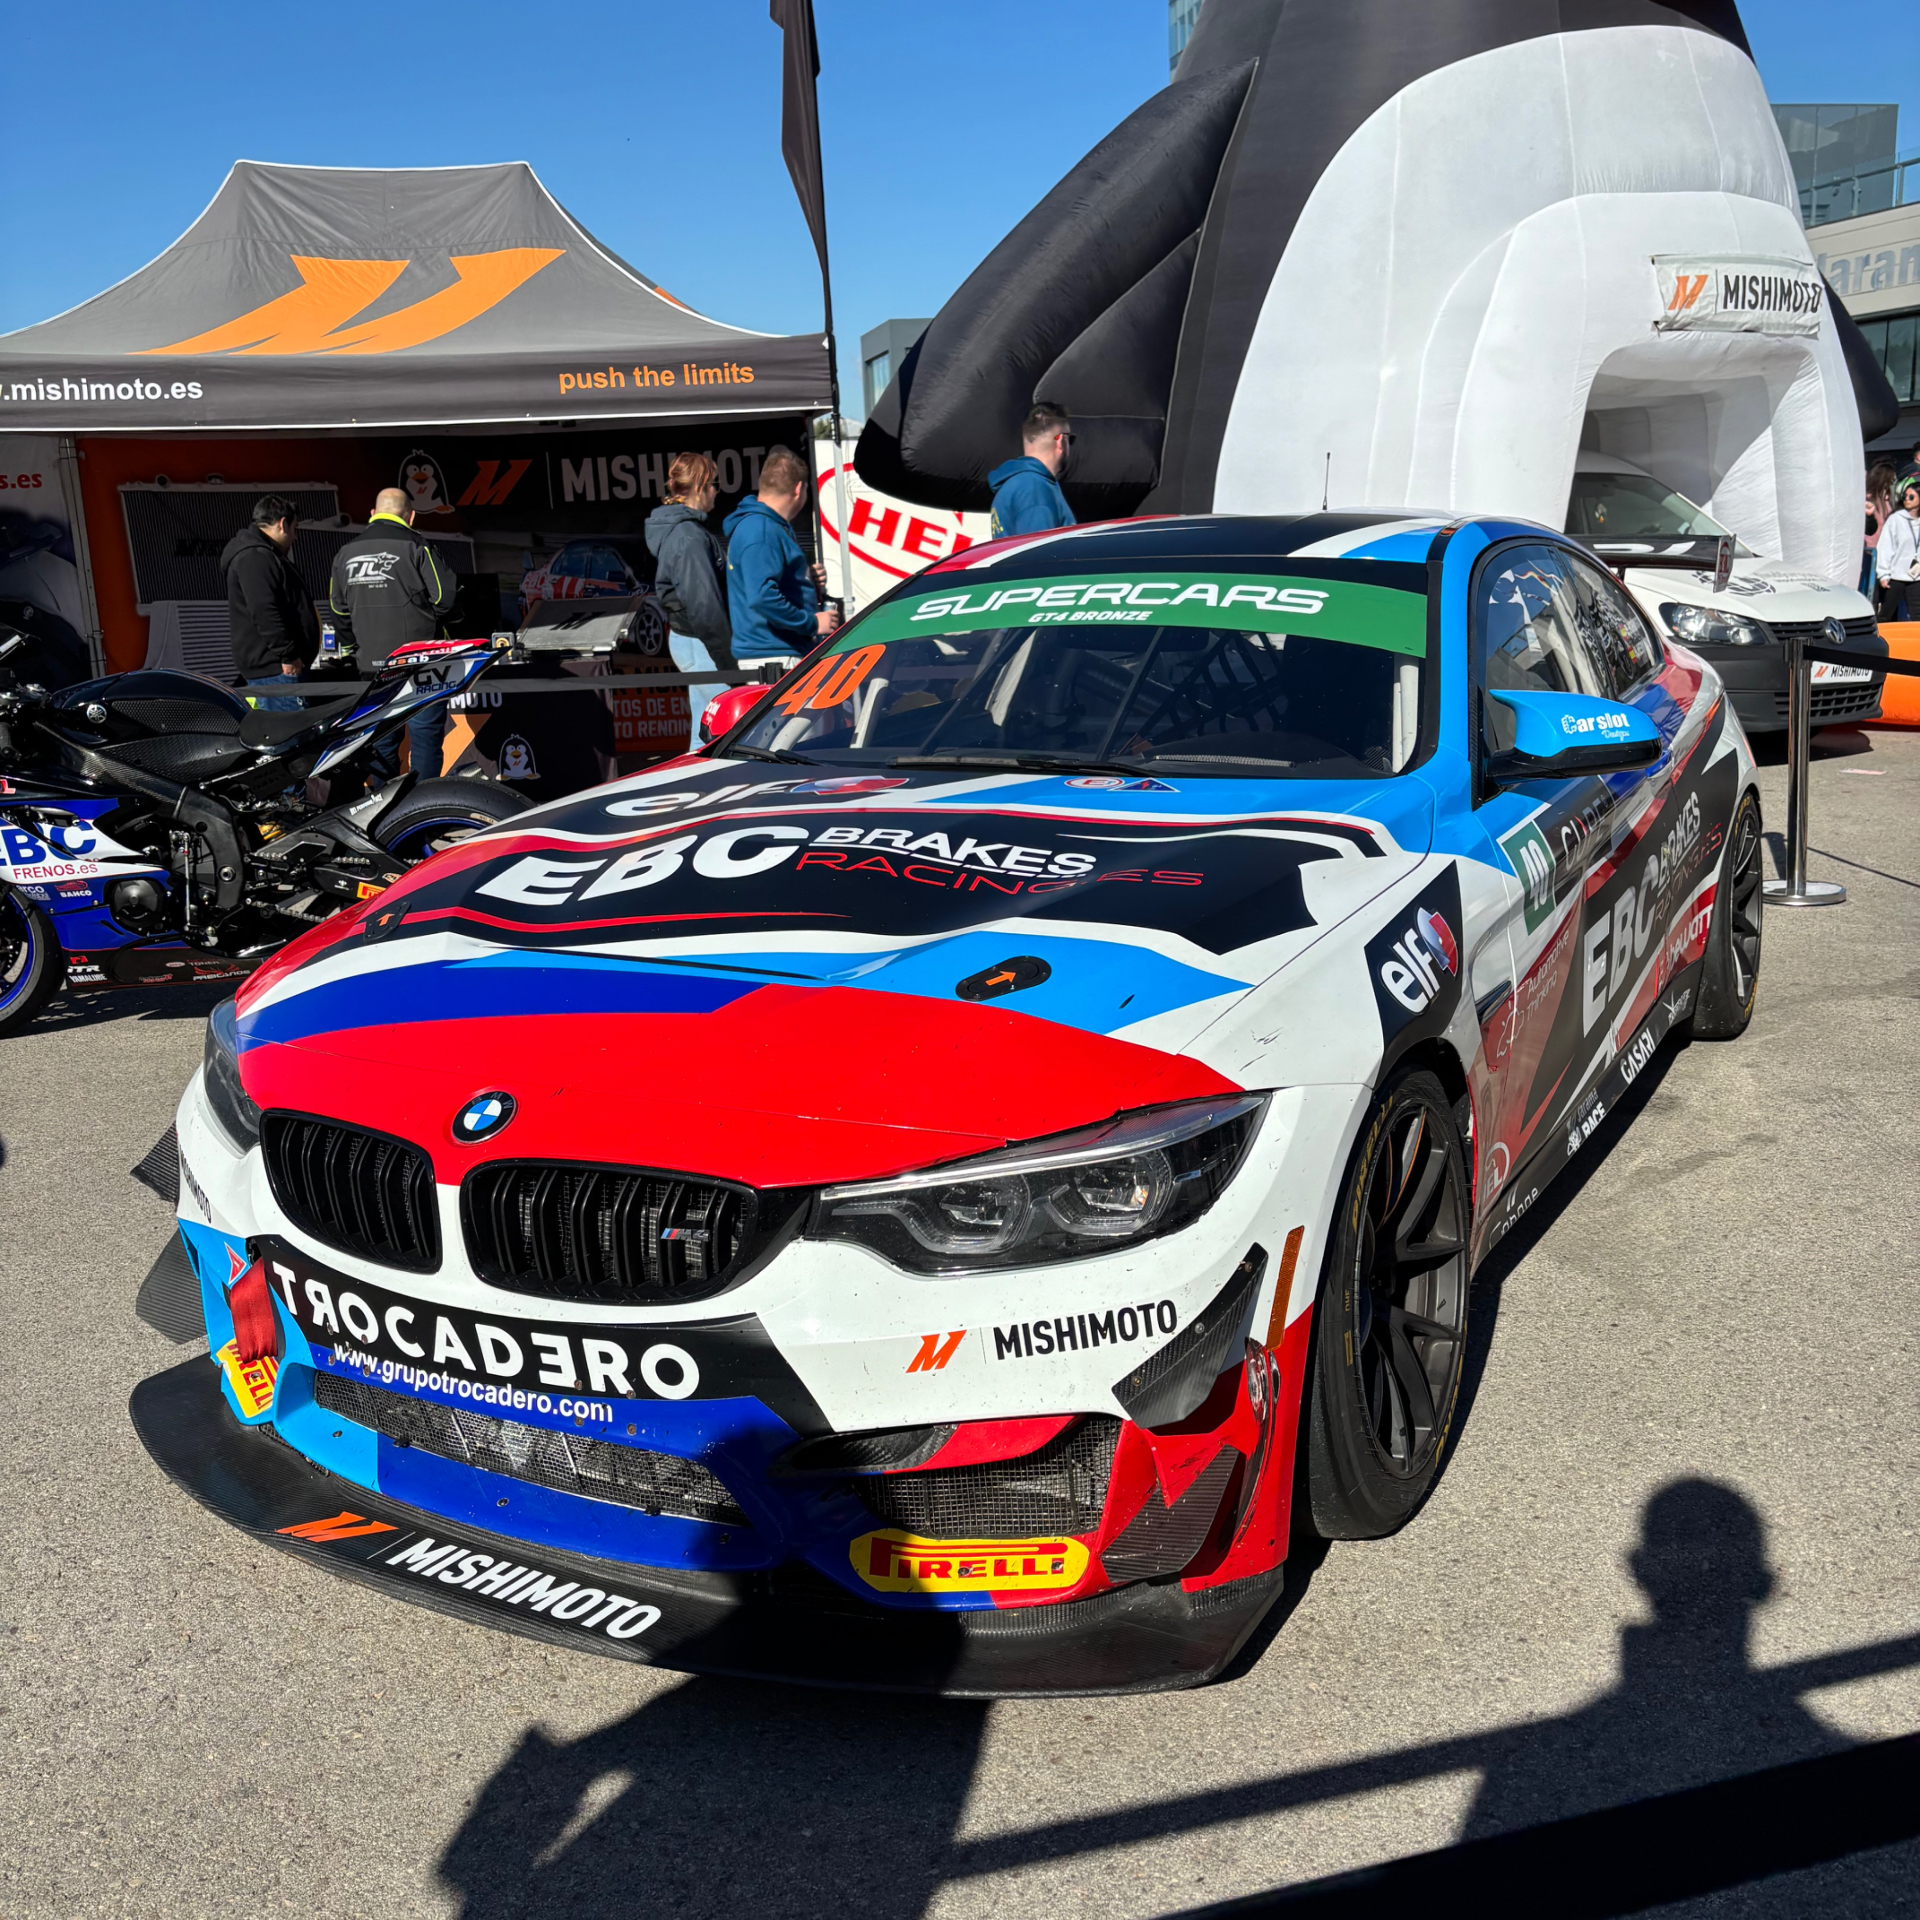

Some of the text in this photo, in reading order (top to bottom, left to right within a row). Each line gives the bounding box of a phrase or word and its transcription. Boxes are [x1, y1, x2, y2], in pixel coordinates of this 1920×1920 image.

[1723, 275, 1823, 313] MISHIMOTO
[0, 378, 203, 400] .mishimoto.es
[559, 362, 754, 394] push the limits
[561, 445, 790, 502] MISHOT
[910, 583, 1330, 622] SUPERCARS
[1027, 610, 1153, 625] GT4 BRONZE
[413, 665, 452, 686] GV
[416, 681, 457, 695] RACING
[773, 644, 886, 715] 40
[1831, 665, 1870, 678] MISHIMOTO
[646, 697, 667, 717] DE
[13, 863, 98, 879] FRENOS.es
[475, 825, 809, 906] EBC
[809, 826, 1097, 875] BRAKES
[1519, 839, 1550, 911] 40
[1583, 855, 1660, 1038] EBC
[69, 973, 108, 983] YAMALUBE
[1381, 927, 1441, 1013] elf
[1581, 1101, 1606, 1138] RACE
[272, 1260, 700, 1401] TROCADERO
[993, 1299, 1178, 1361] MISHIMOTO
[334, 1342, 614, 1424] www.grupotrocadero.com
[868, 1536, 1068, 1579] PIRELLI
[386, 1537, 662, 1639] MISHIMOTO
